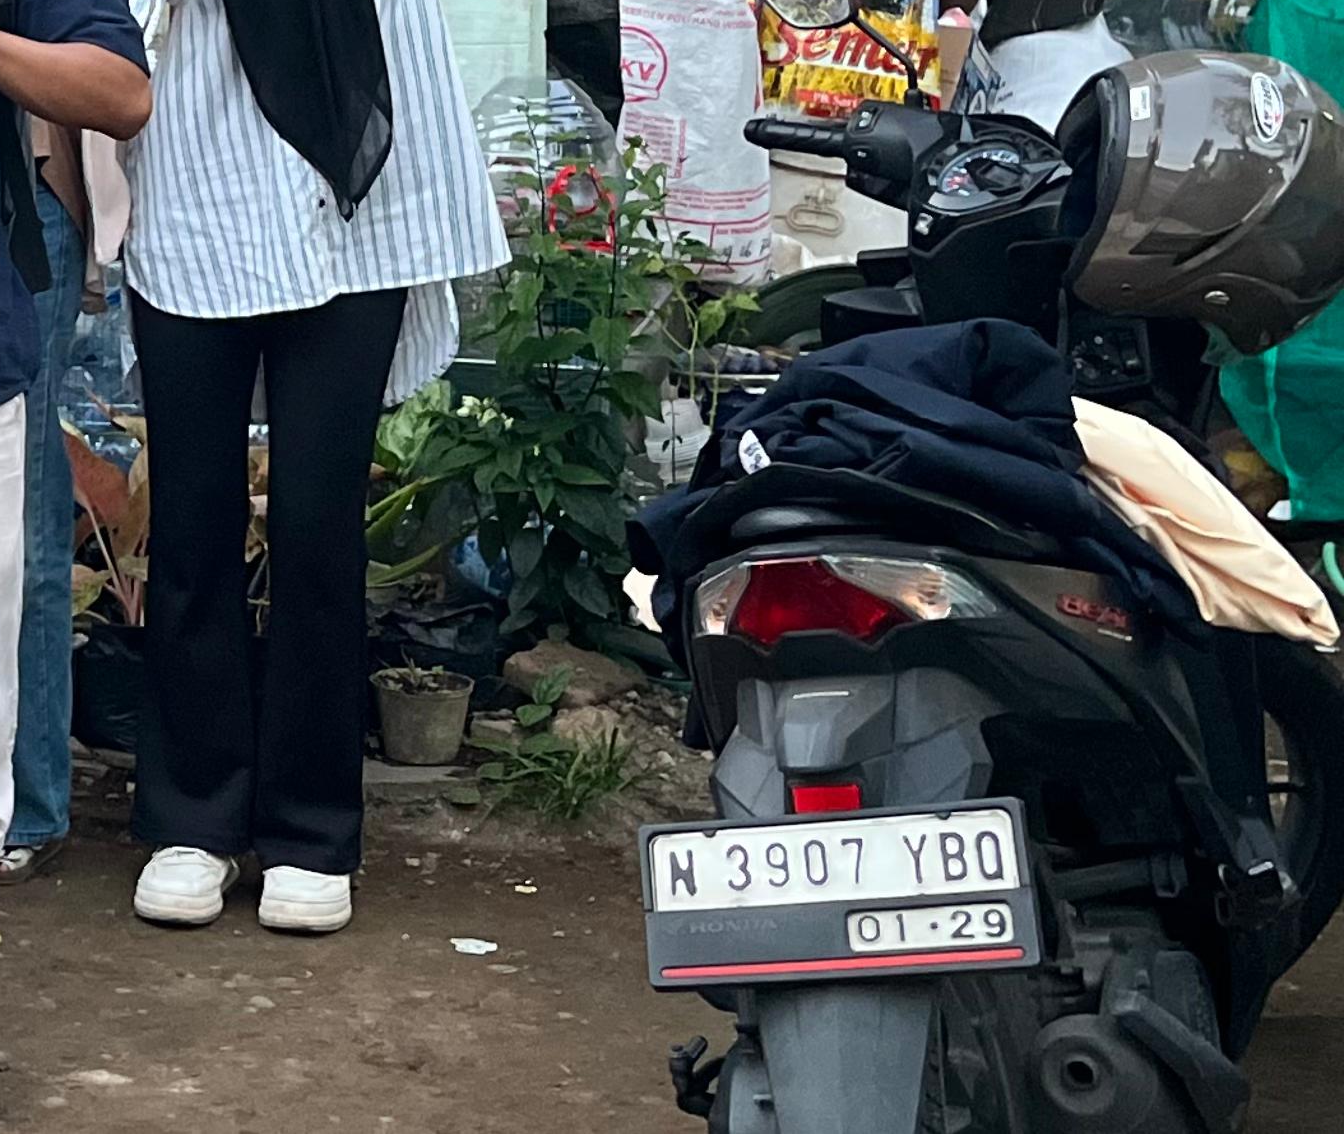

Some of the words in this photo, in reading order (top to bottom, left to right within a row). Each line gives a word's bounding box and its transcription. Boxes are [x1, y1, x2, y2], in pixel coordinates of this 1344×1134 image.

[668, 849, 698, 897] N
[726, 837, 864, 891] 3907
[902, 830, 1005, 884] YBQ
